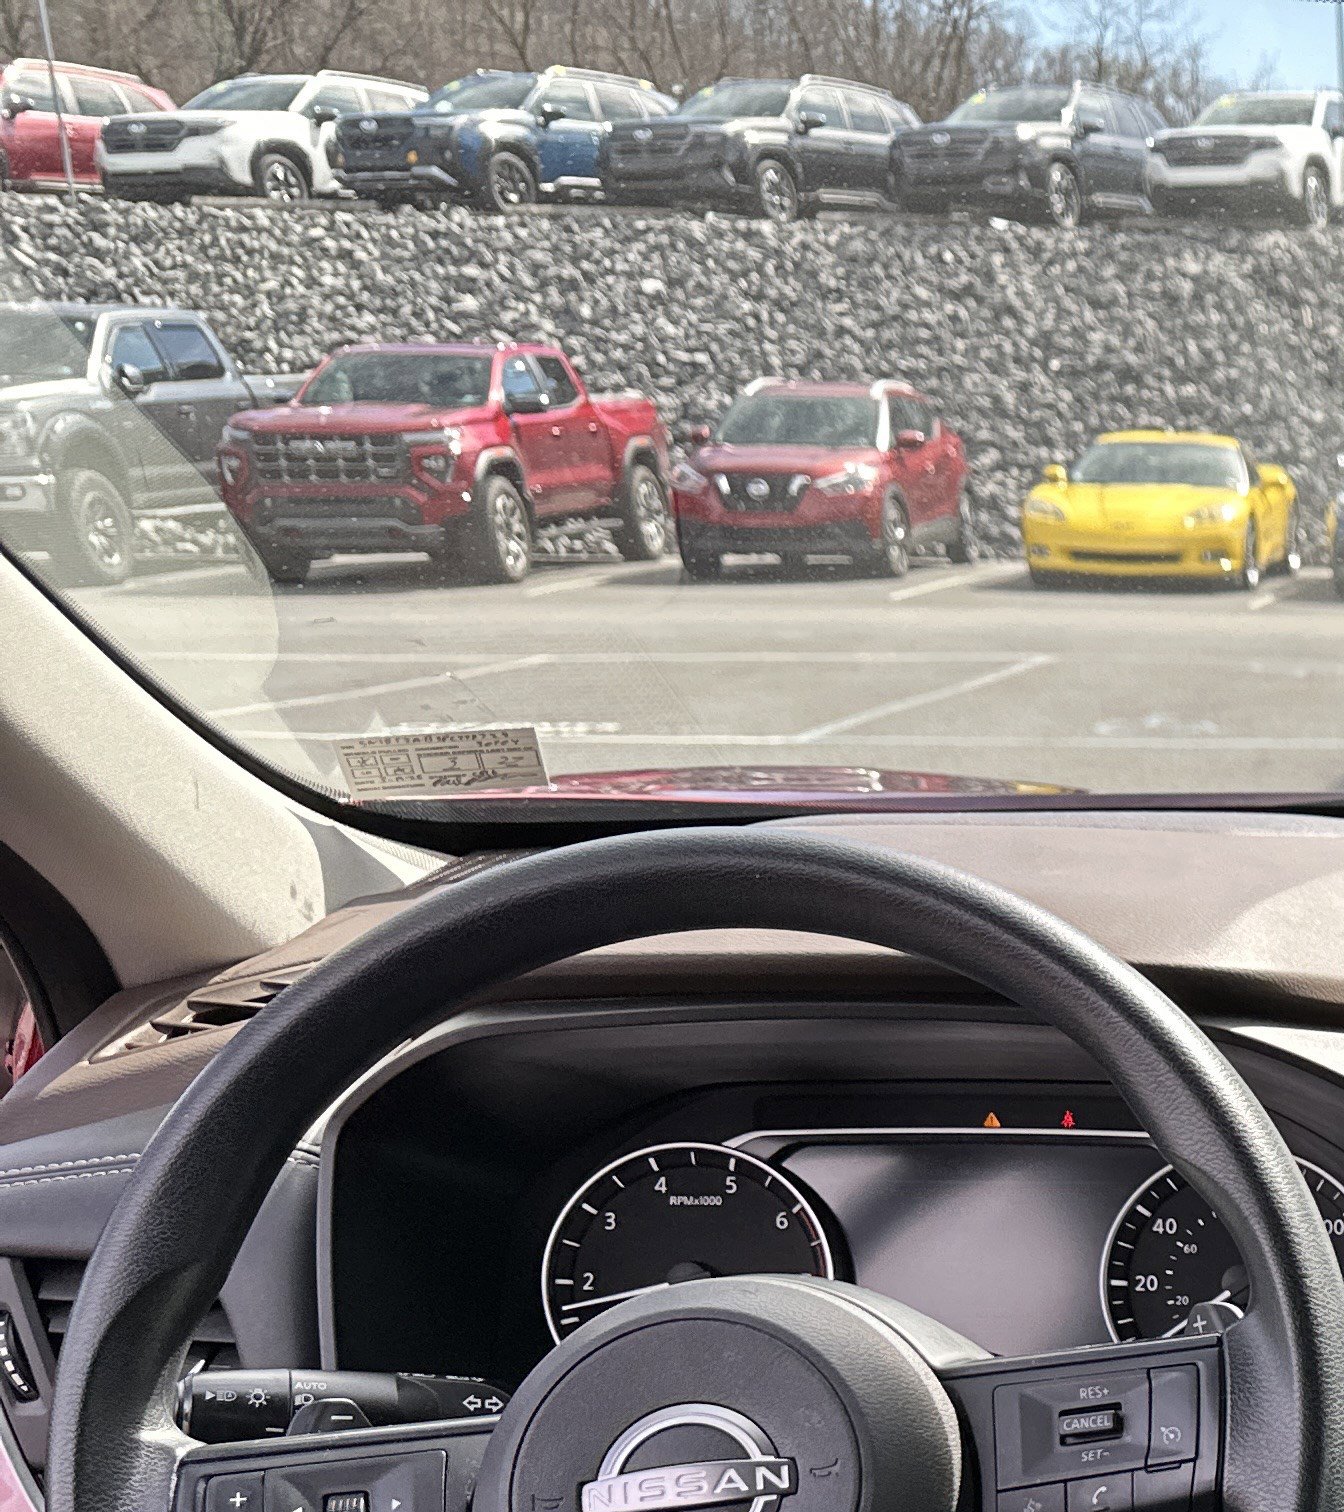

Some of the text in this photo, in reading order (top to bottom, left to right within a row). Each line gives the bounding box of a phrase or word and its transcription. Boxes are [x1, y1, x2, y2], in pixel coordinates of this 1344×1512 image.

[654, 1176, 668, 1194] 4
[725, 1176, 738, 1194] 5
[604, 1212, 617, 1231] 3
[775, 1211, 789, 1230] 6
[1152, 1217, 1178, 1235] 40
[1323, 1218, 1344, 1236] 00
[1183, 1243, 1198, 1254] 60
[582, 1271, 595, 1291] 2
[1135, 1274, 1158, 1292] 20
[1175, 1295, 1190, 1306] 20
[294, 1381, 328, 1390] AUTO
[1079, 1385, 1110, 1400] RES+
[1062, 1410, 1112, 1431] CANCEL
[588, 1464, 790, 1511] NISSAN
